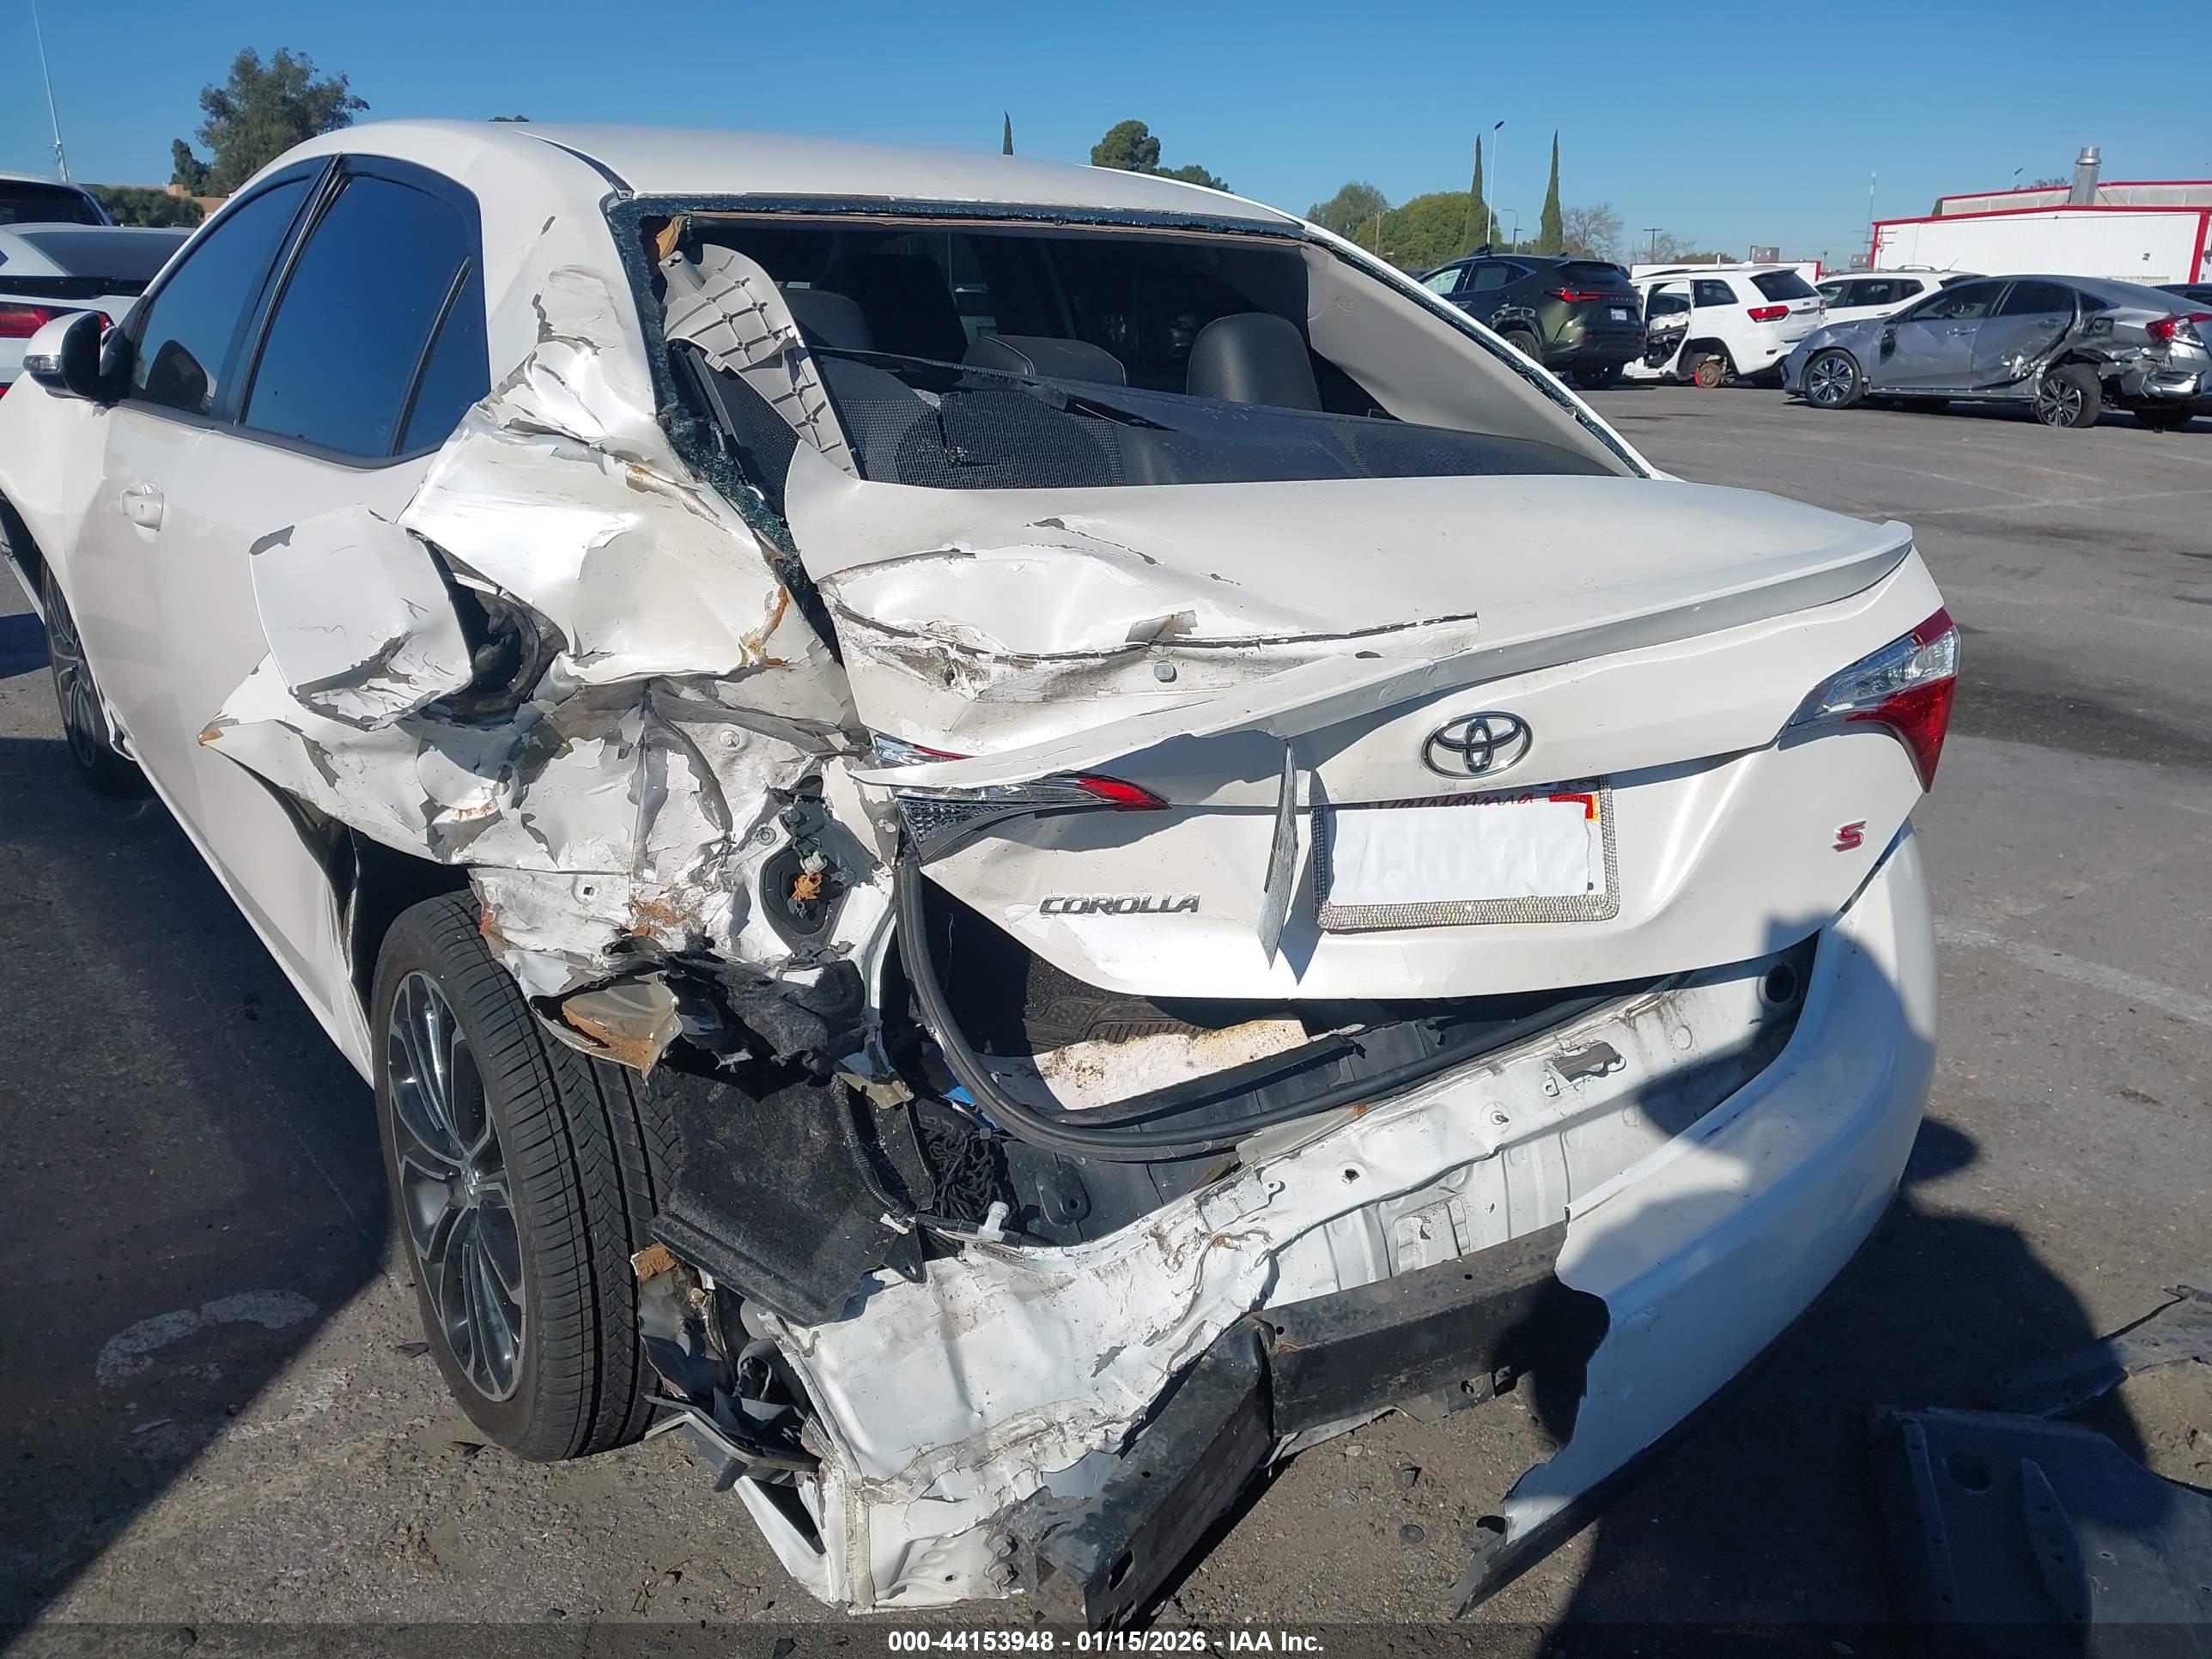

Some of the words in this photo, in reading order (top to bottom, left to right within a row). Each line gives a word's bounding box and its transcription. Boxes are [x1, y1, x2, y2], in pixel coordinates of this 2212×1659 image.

[1388, 791, 1534, 808] aornia
[1832, 819, 1867, 853] S
[1039, 893, 1200, 915] COROLLA
